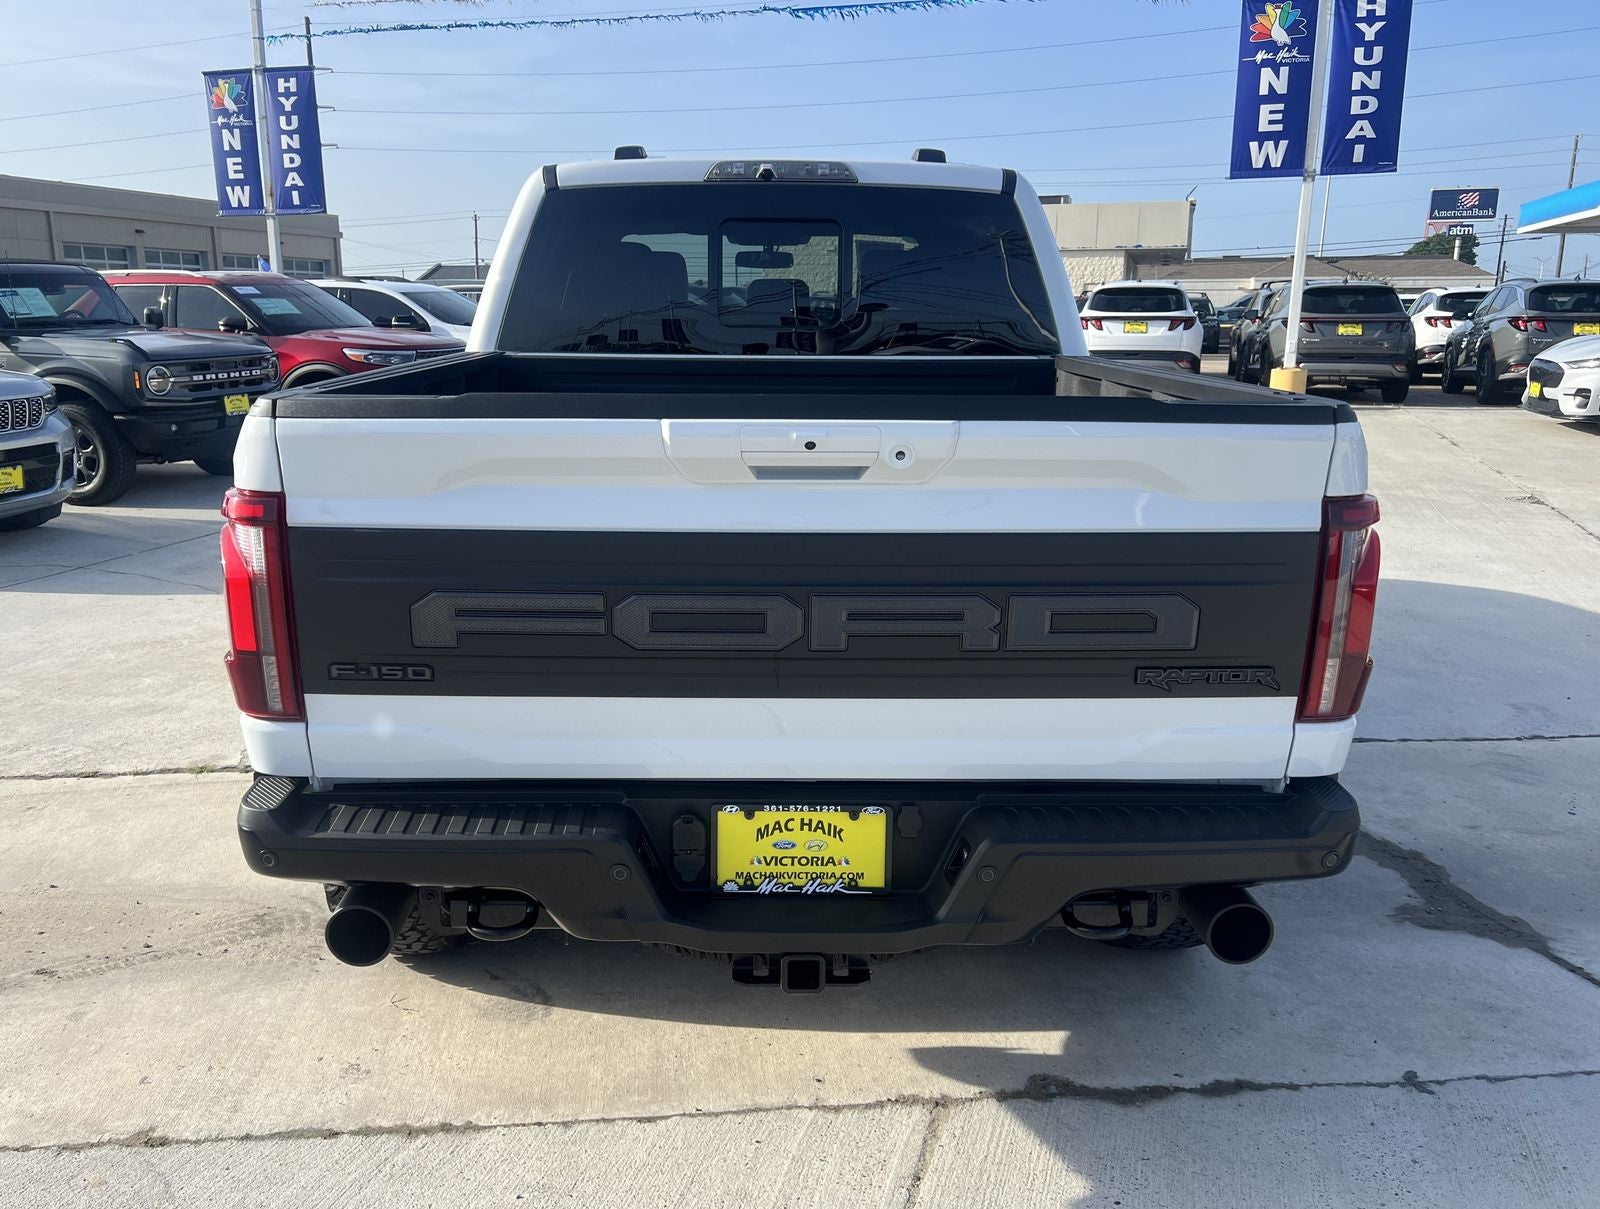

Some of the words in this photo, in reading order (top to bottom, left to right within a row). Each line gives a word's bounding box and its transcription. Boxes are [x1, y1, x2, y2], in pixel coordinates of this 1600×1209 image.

[1254, 49, 1277, 64] Mac
[1276, 46, 1301, 64] Haik
[1345, 0, 1387, 163] HYUNDAI
[1249, 66, 1289, 169] NEW
[277, 77, 305, 206] HYUNDAI
[221, 128, 251, 208] NEW
[1449, 226, 1473, 236] atm
[192, 369, 261, 381] BRONCO
[409, 590, 1200, 652] FORD
[329, 663, 433, 680] F-150
[1135, 667, 1280, 691] RAPTOR
[763, 804, 842, 813] 361-576-1221
[756, 818, 795, 843] MAC
[799, 818, 844, 843] HAIK
[763, 855, 837, 867] VICTORIA
[735, 871, 865, 880] MACHAIKVICTORIACOM
[756, 878, 800, 895] Mac
[801, 878, 848, 895] Haik
